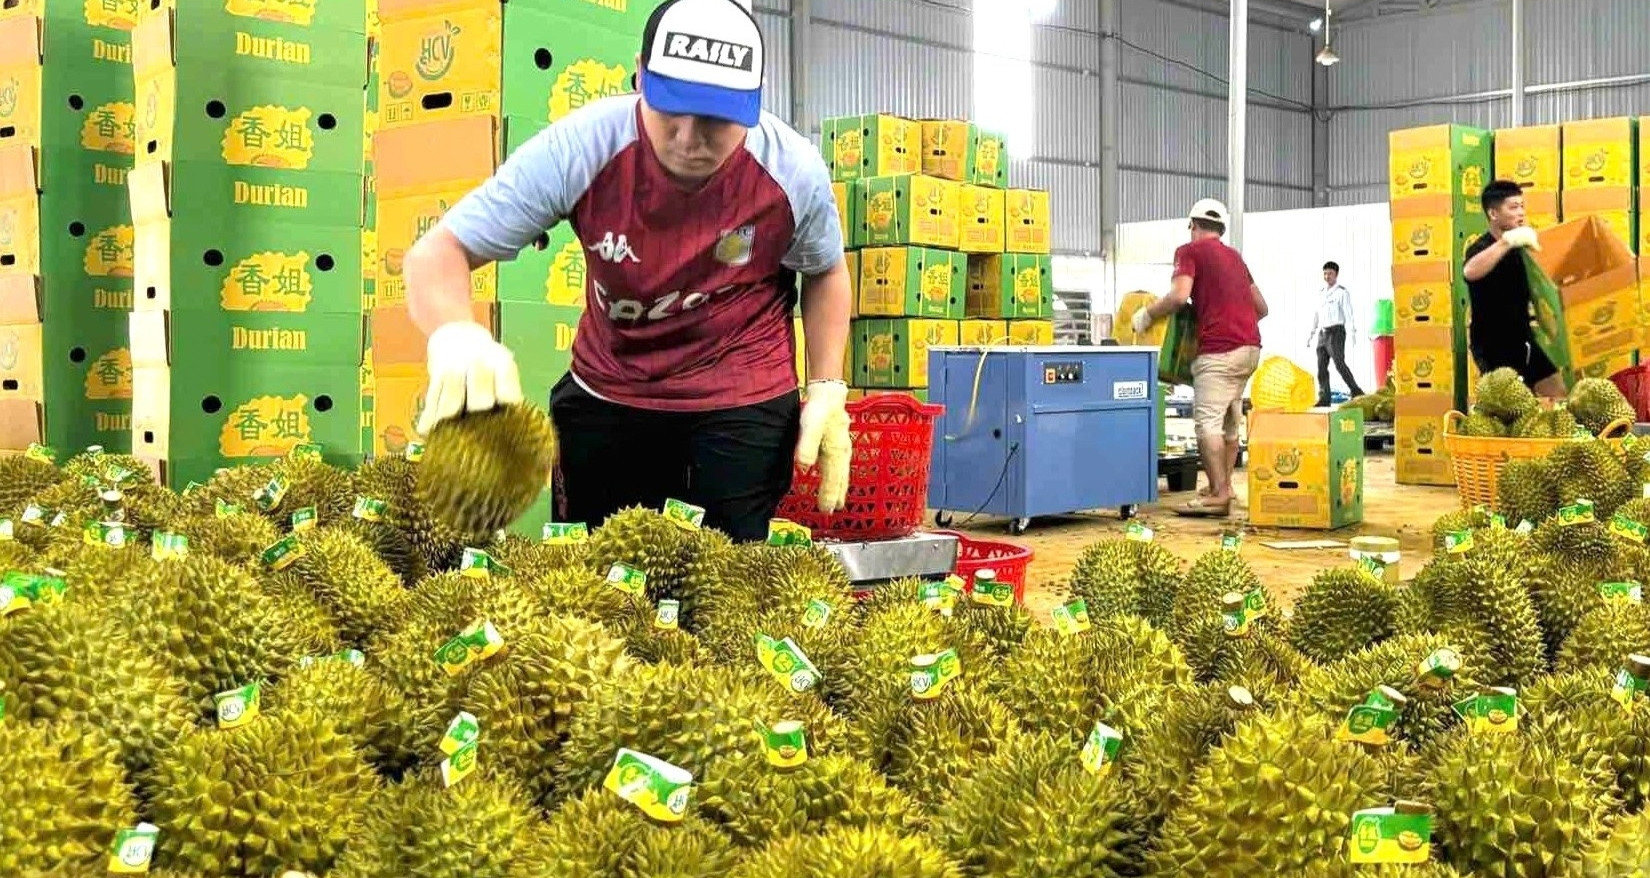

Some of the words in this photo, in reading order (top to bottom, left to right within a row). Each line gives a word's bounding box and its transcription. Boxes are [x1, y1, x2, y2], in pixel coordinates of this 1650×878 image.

[236, 31, 310, 64] Durian
[421, 36, 450, 61] HCV
[668, 34, 749, 67] RAILY
[237, 116, 308, 151] 香姐
[234, 180, 308, 208] Durian
[235, 263, 306, 297] 香姐
[232, 326, 306, 350] Durian
[235, 408, 305, 441] 香姐
